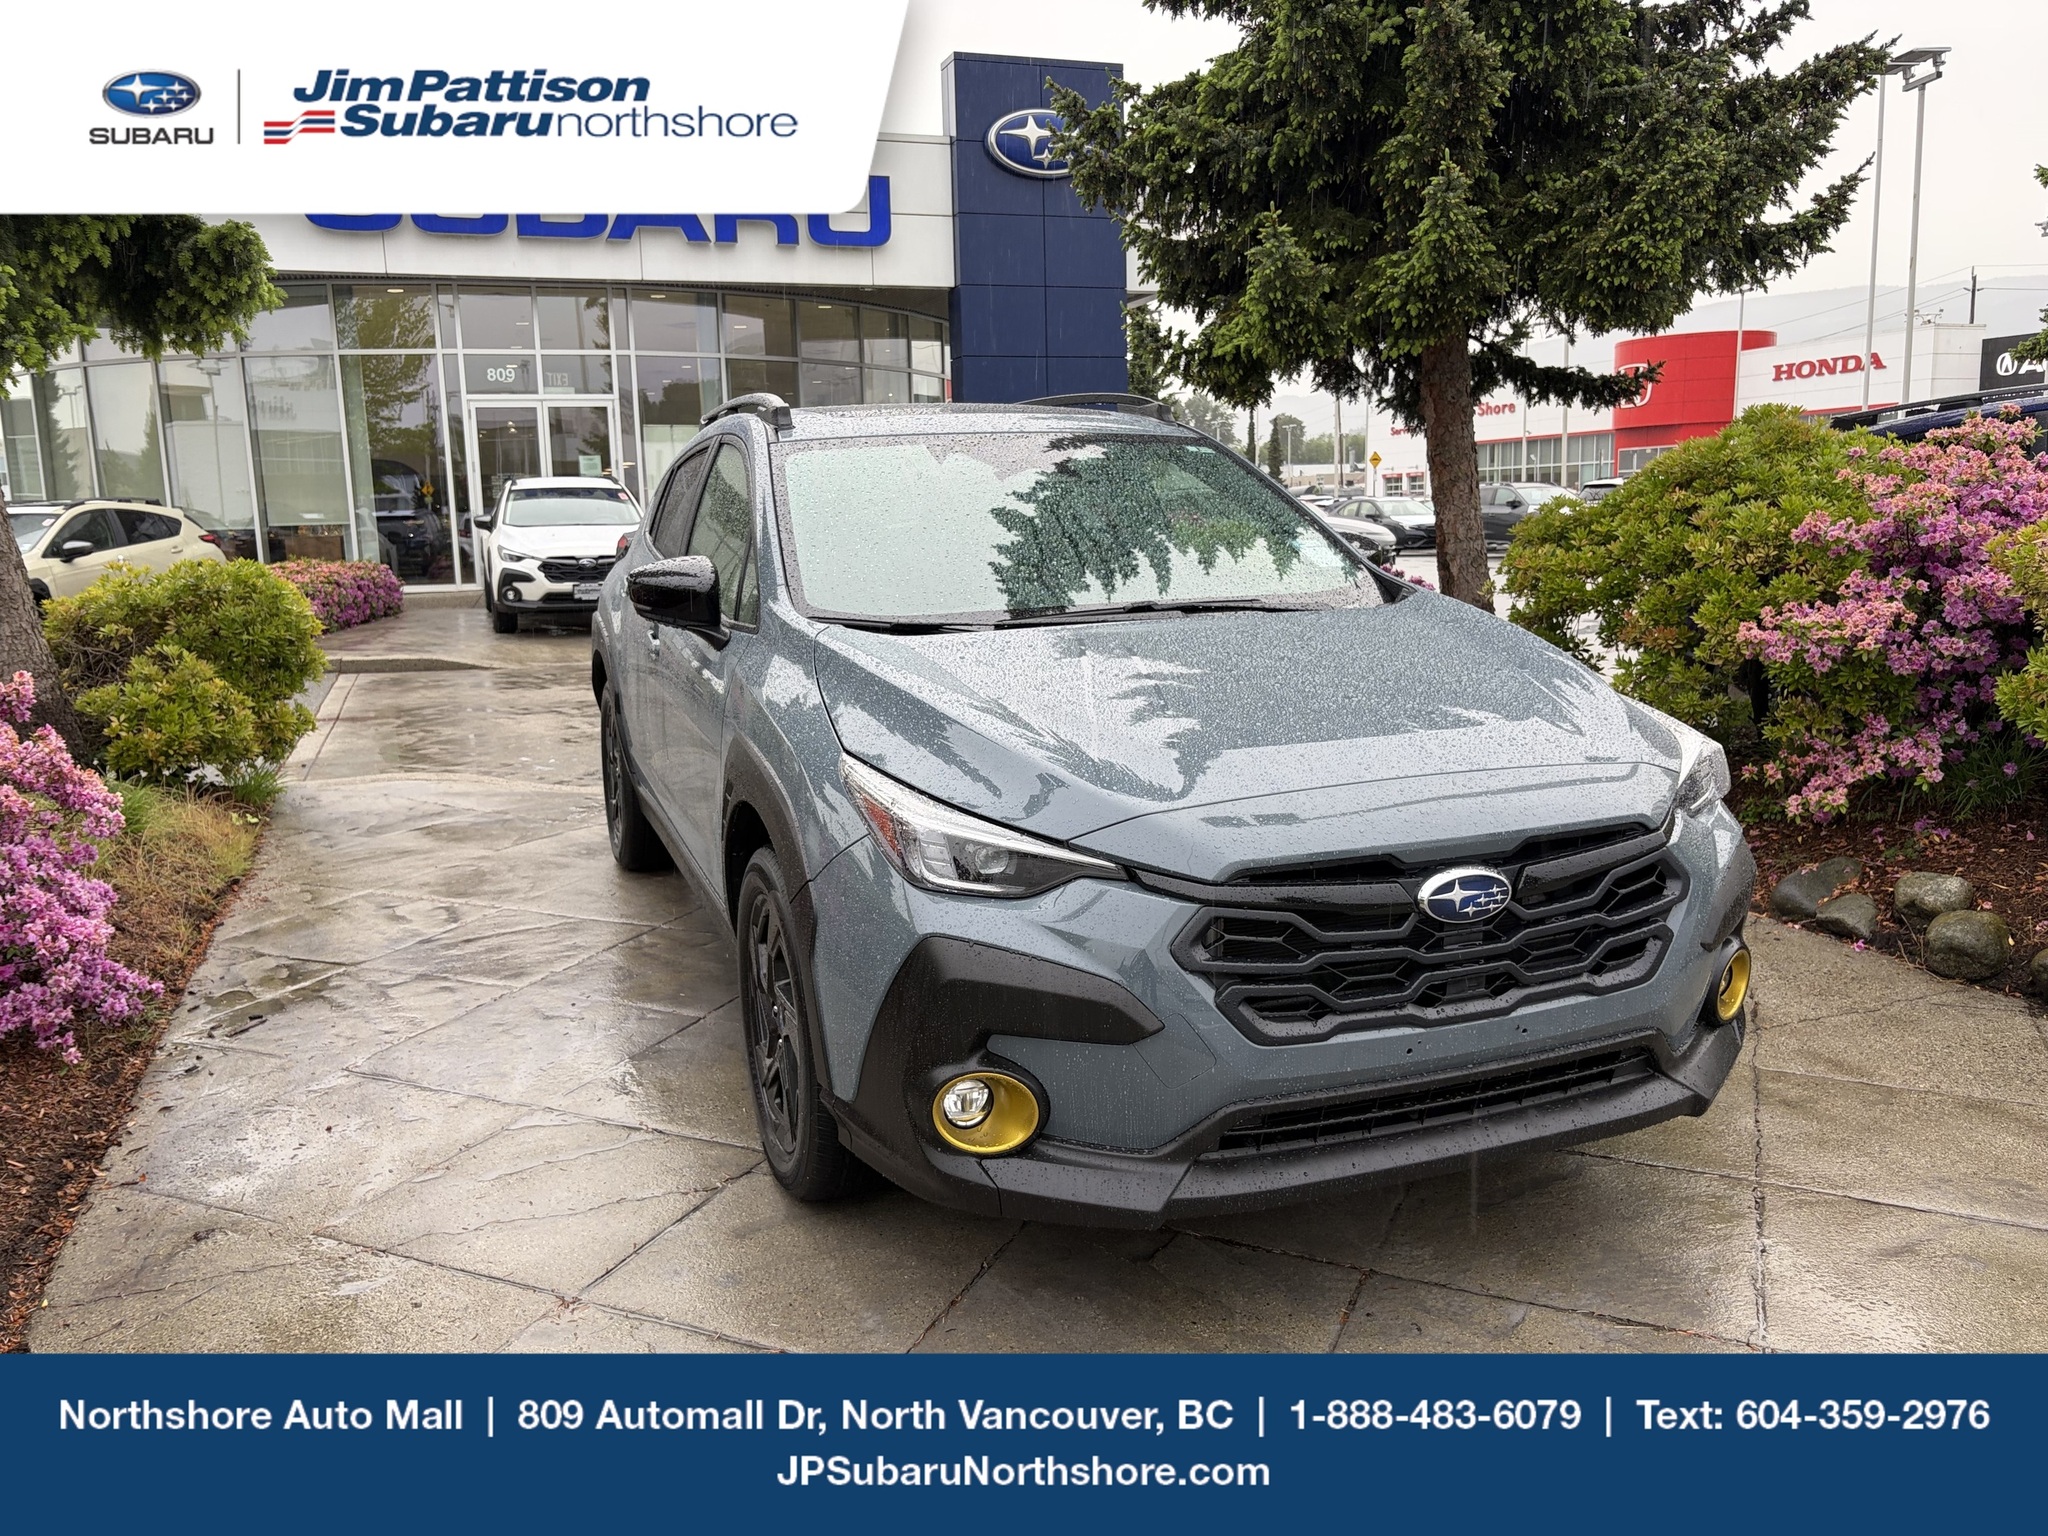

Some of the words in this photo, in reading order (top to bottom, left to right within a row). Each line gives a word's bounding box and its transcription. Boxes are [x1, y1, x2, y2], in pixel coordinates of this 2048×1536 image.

[487, 367, 516, 382] 809
[1772, 352, 1887, 382] HONDA
[1477, 401, 1516, 417] Shore
